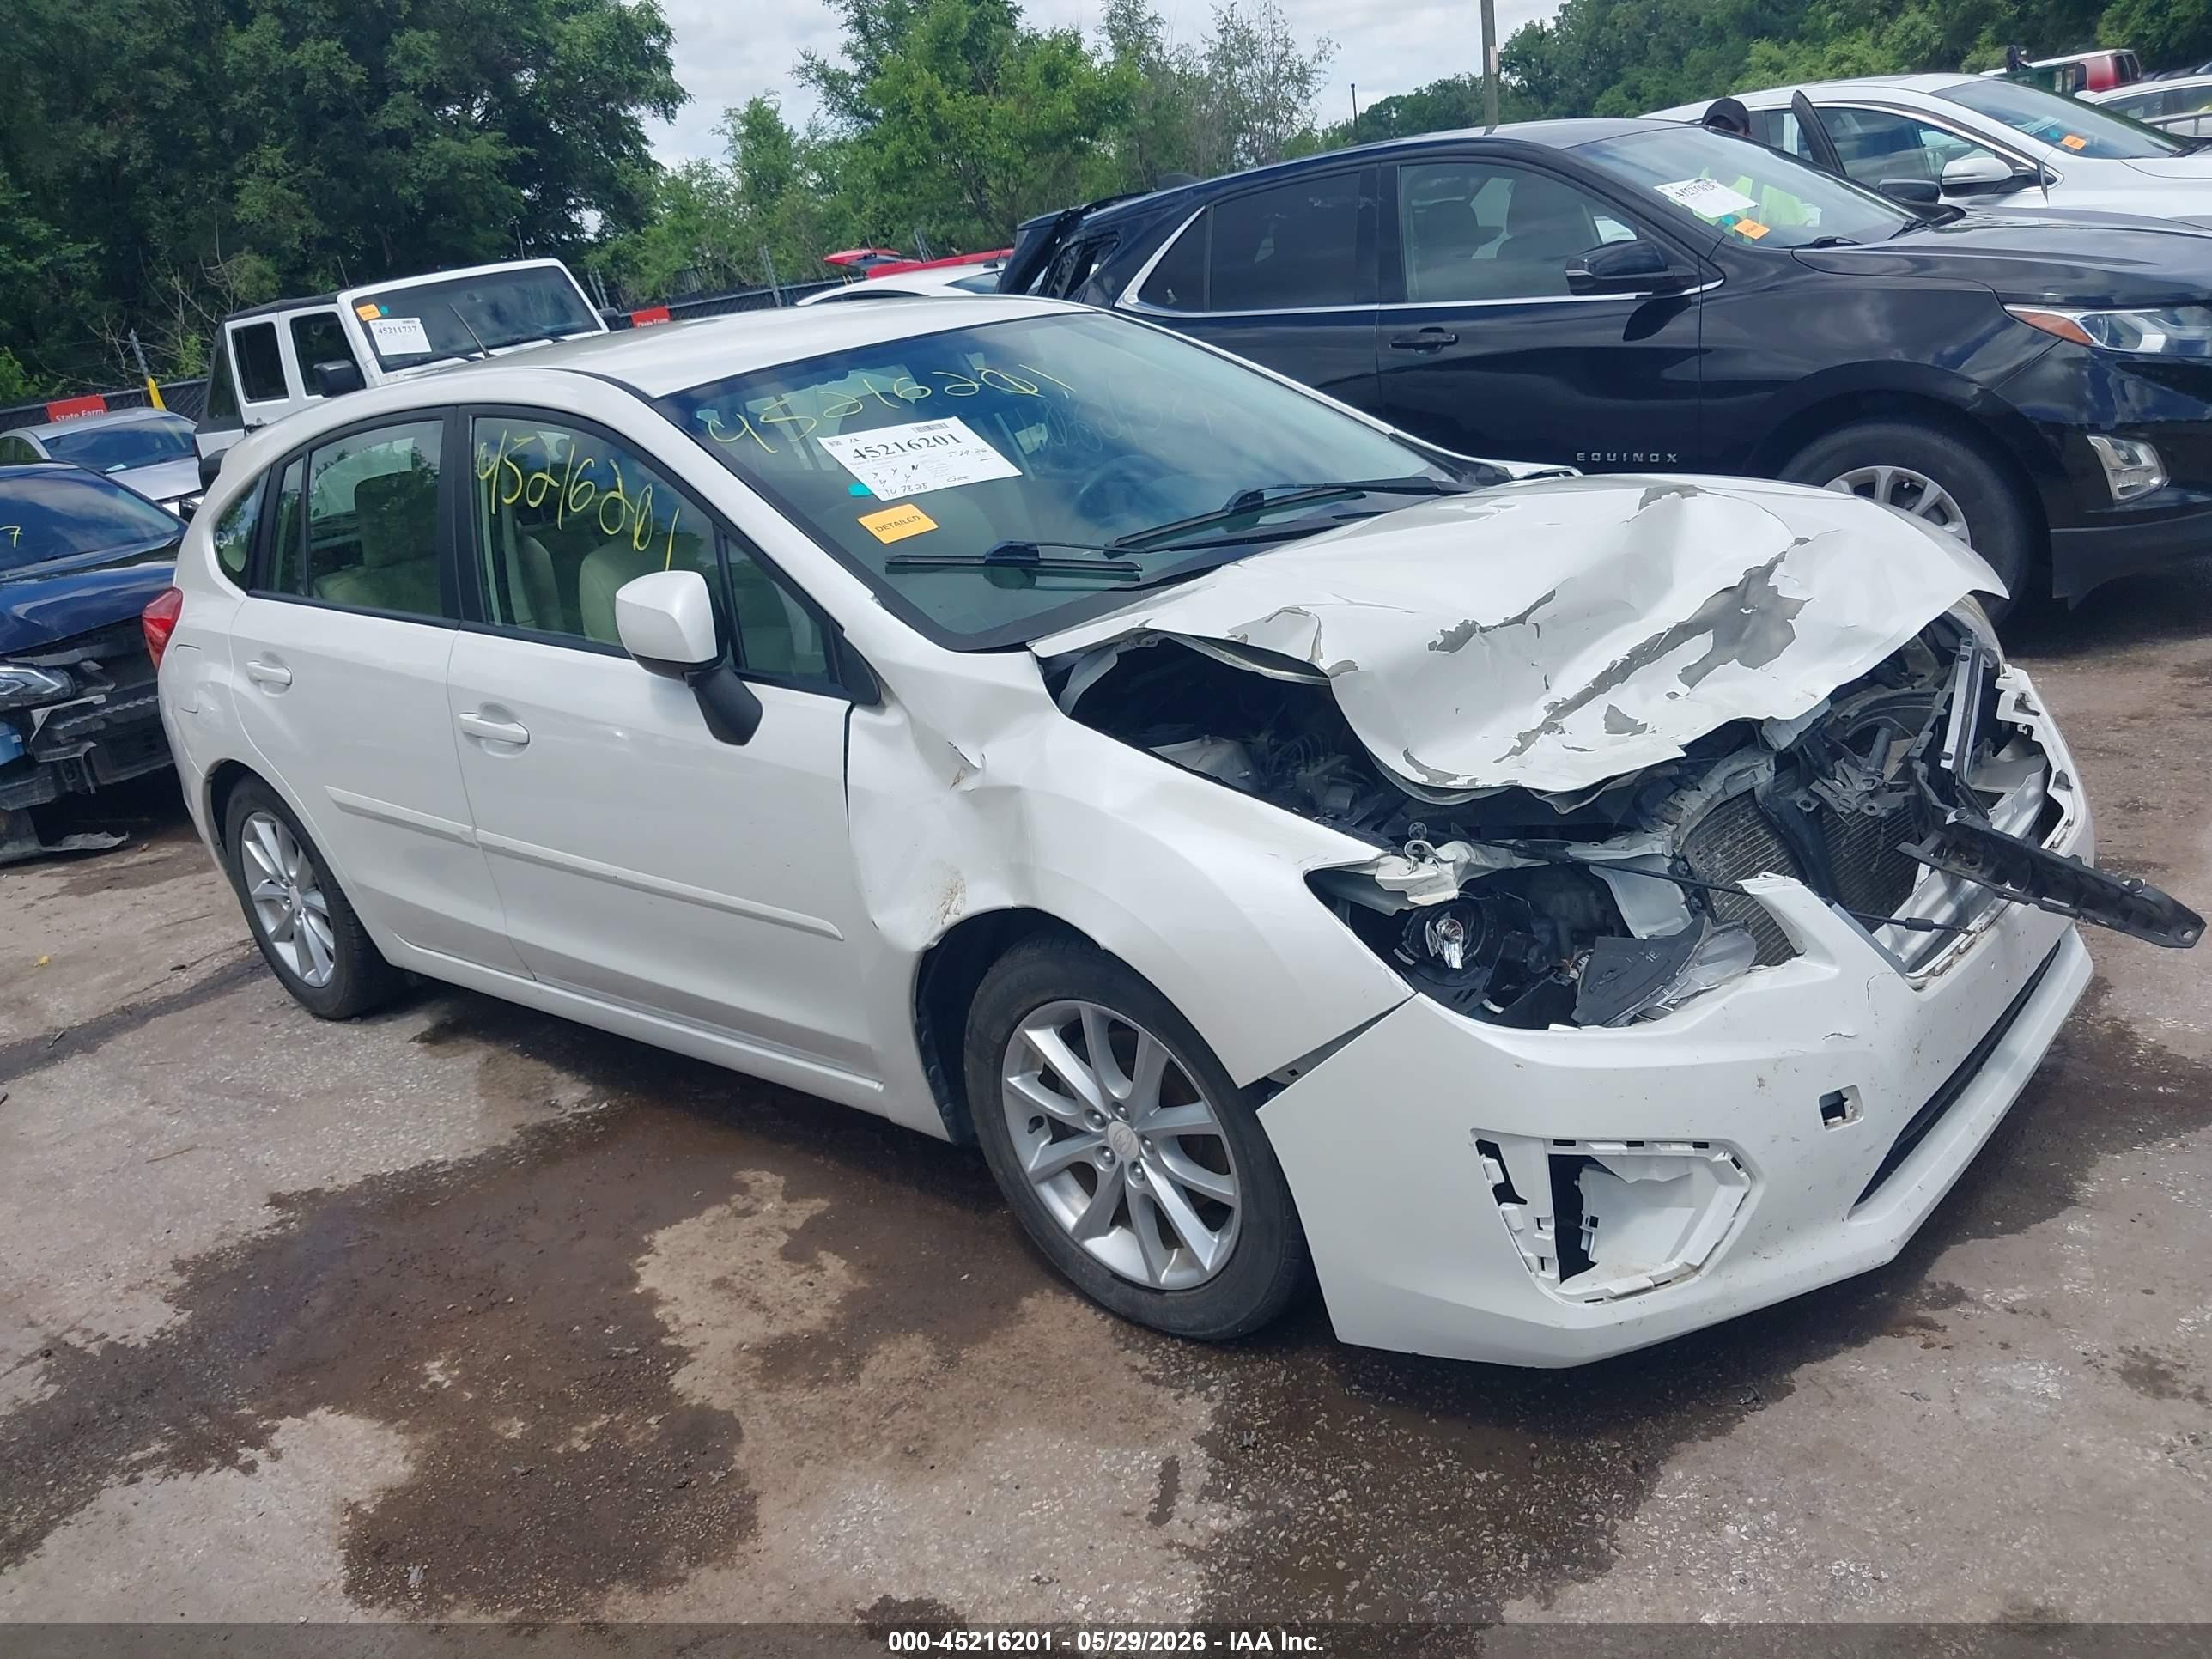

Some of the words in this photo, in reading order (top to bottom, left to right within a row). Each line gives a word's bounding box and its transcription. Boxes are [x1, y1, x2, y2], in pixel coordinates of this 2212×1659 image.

[708, 363, 1077, 453] 45216201
[852, 433, 961, 460] 45216201
[1577, 453, 1677, 463] EQUINOX
[477, 429, 680, 571] 45216201
[874, 515, 921, 532] DETAILED
